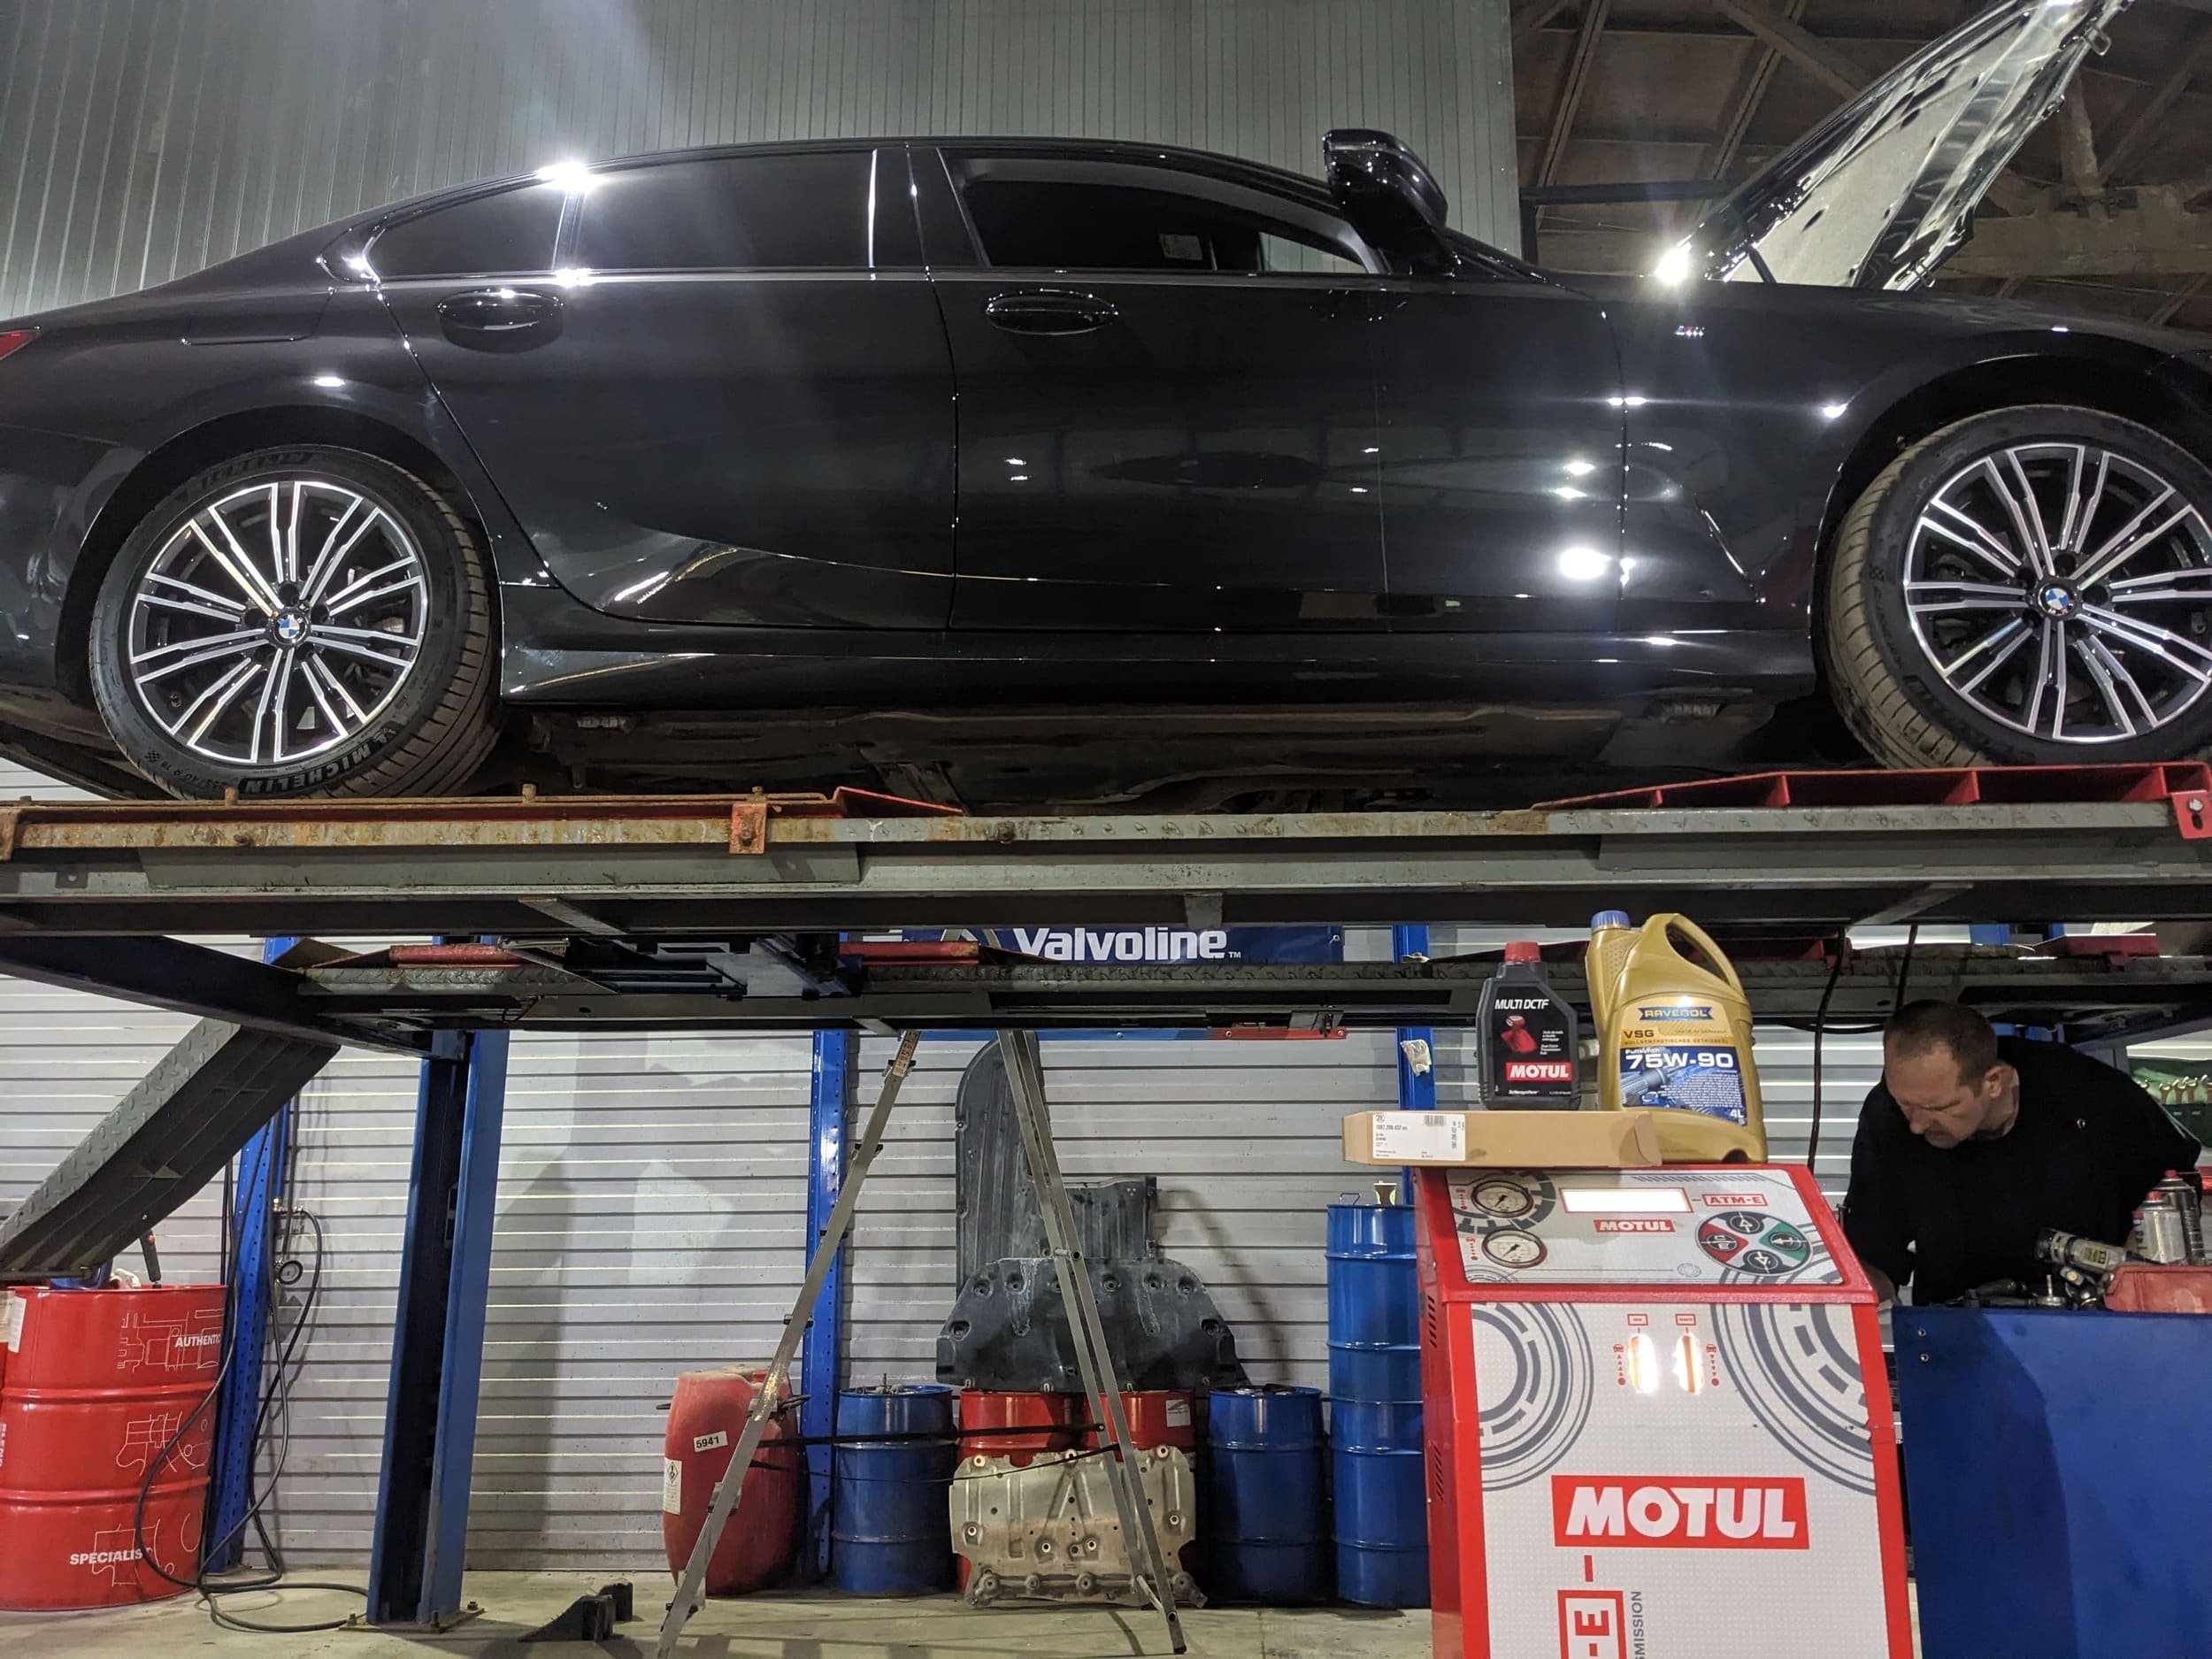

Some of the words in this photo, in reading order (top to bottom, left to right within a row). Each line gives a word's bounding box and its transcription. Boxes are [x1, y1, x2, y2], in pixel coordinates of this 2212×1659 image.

[245, 741, 372, 794] MICHELIN
[1012, 927, 1227, 961] Valvoline
[1494, 999, 1523, 1010] MULTI
[1524, 999, 1549, 1010] DCTF
[1644, 1009, 1708, 1018] RAVENOL
[1624, 1029, 1654, 1039] VSG
[1625, 1052, 1734, 1070] 75W-90
[1509, 1064, 1569, 1079] MOTUL
[1730, 1109, 1745, 1118] 4L
[1599, 1221, 1671, 1232] MOTUL
[695, 1435, 719, 1448] 5941
[1565, 1486, 1796, 1539] MOTUL
[70, 1548, 145, 1565] SPECIALIS
